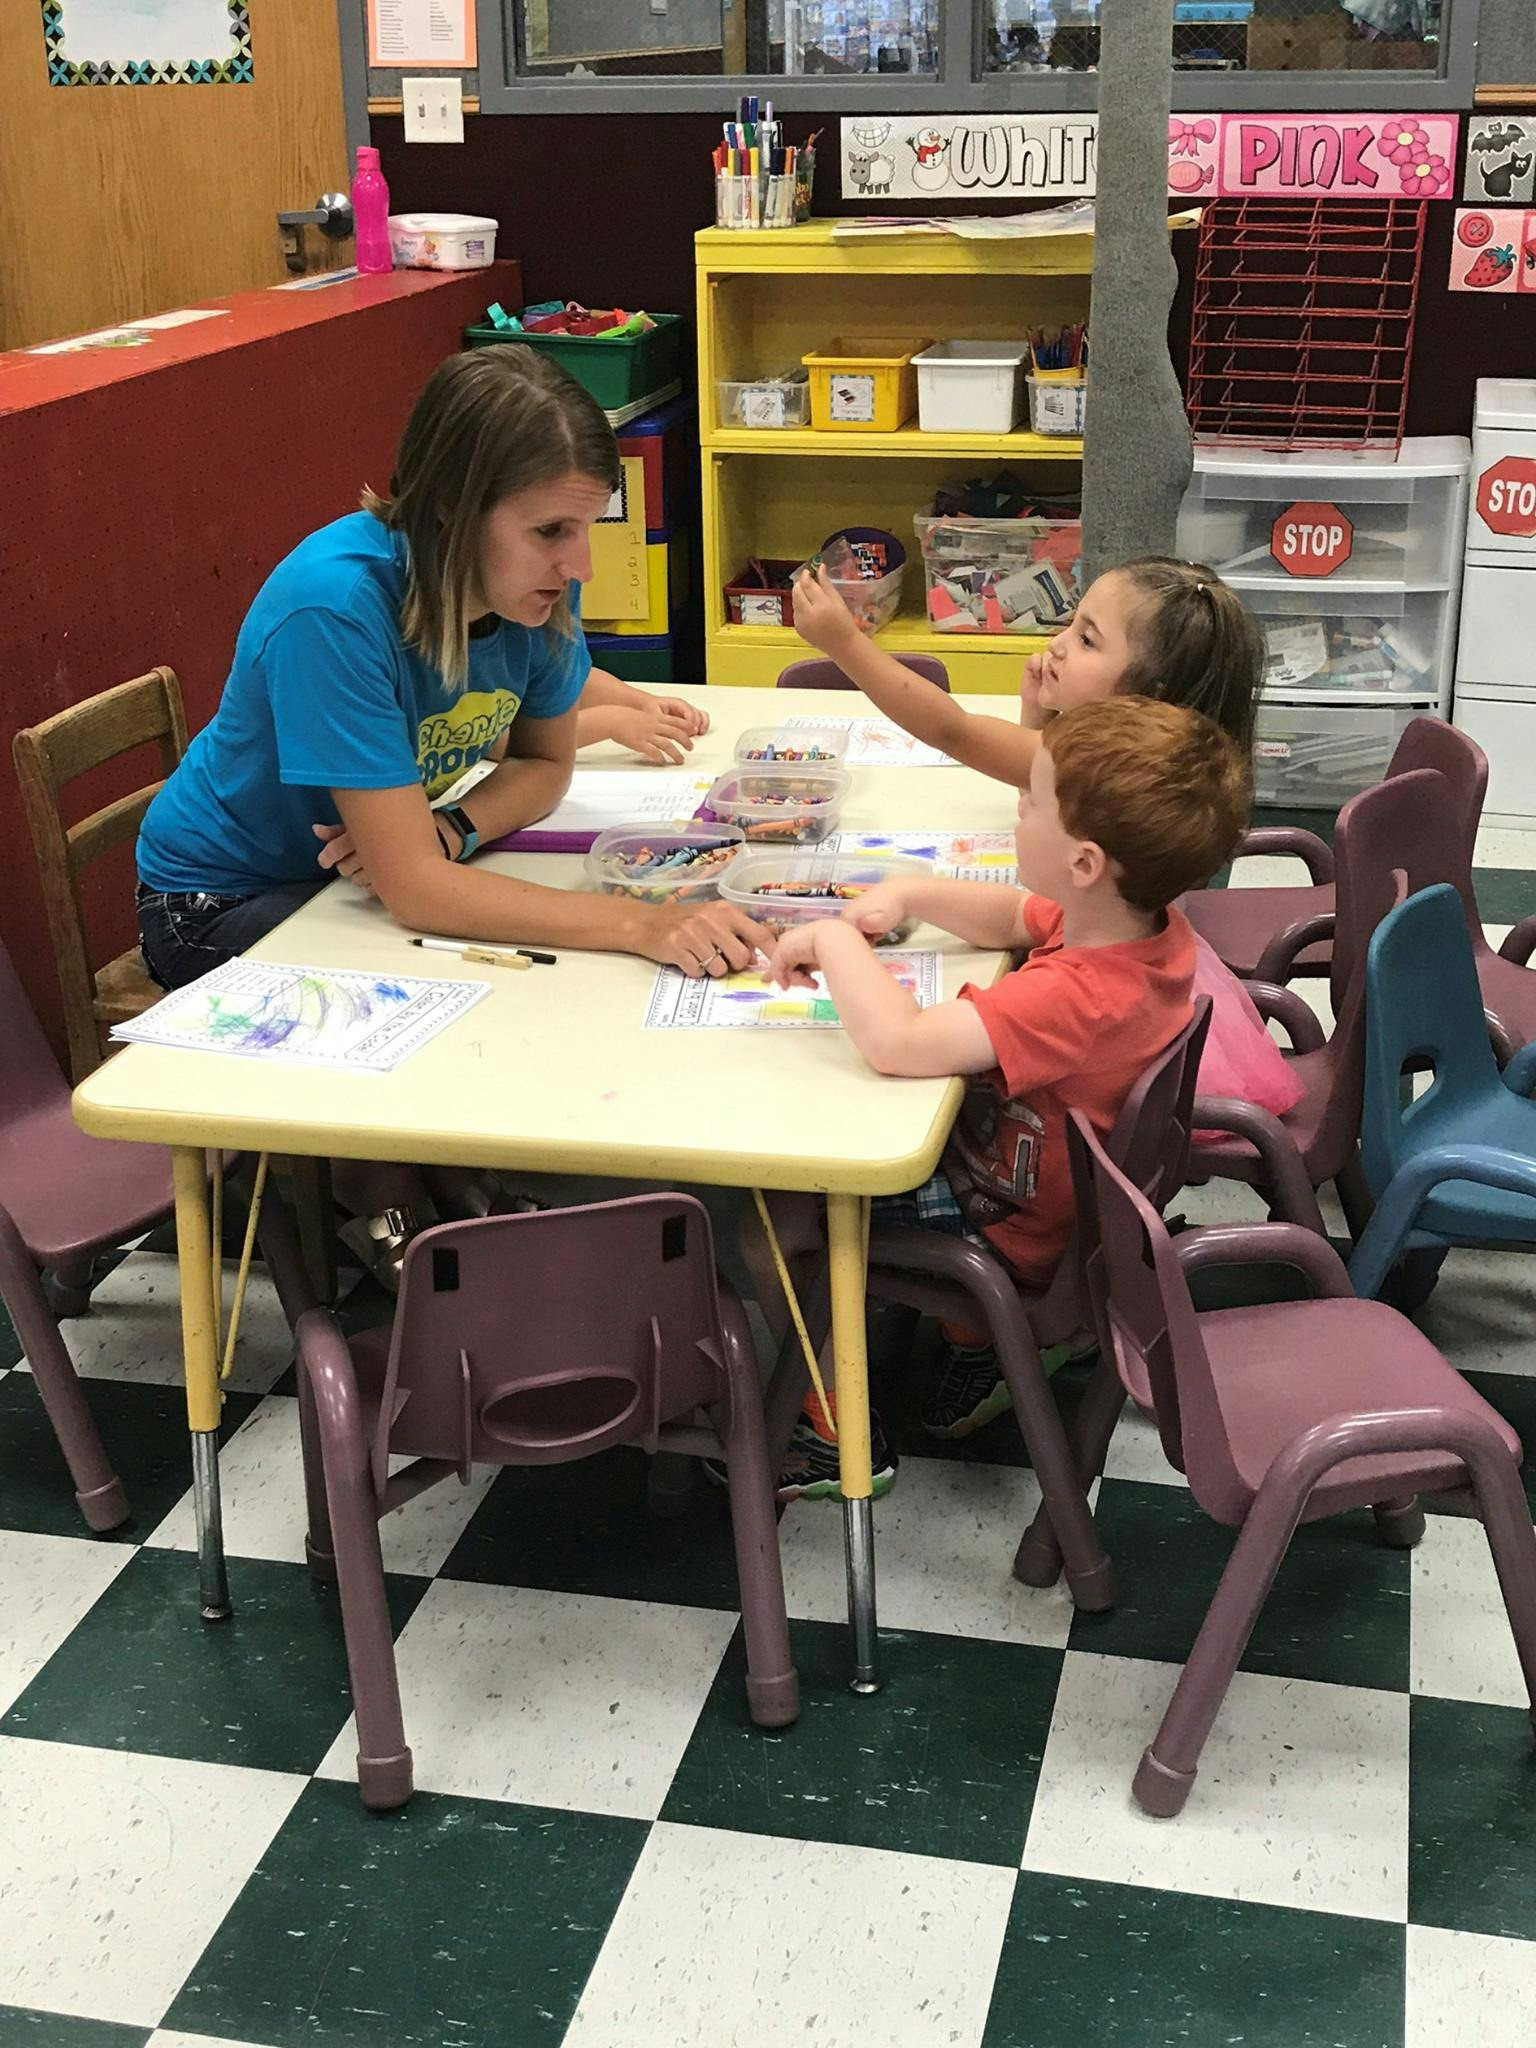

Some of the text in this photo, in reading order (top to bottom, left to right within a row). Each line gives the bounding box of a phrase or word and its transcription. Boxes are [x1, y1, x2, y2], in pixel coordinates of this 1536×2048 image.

[950, 125, 1099, 188] WhIT
[1488, 478, 1536, 517] STO
[628, 531, 641, 545] 1
[1283, 523, 1344, 558] STOP
[627, 556, 638, 568] 2
[629, 573, 640, 587] 3
[629, 599, 640, 611] 4
